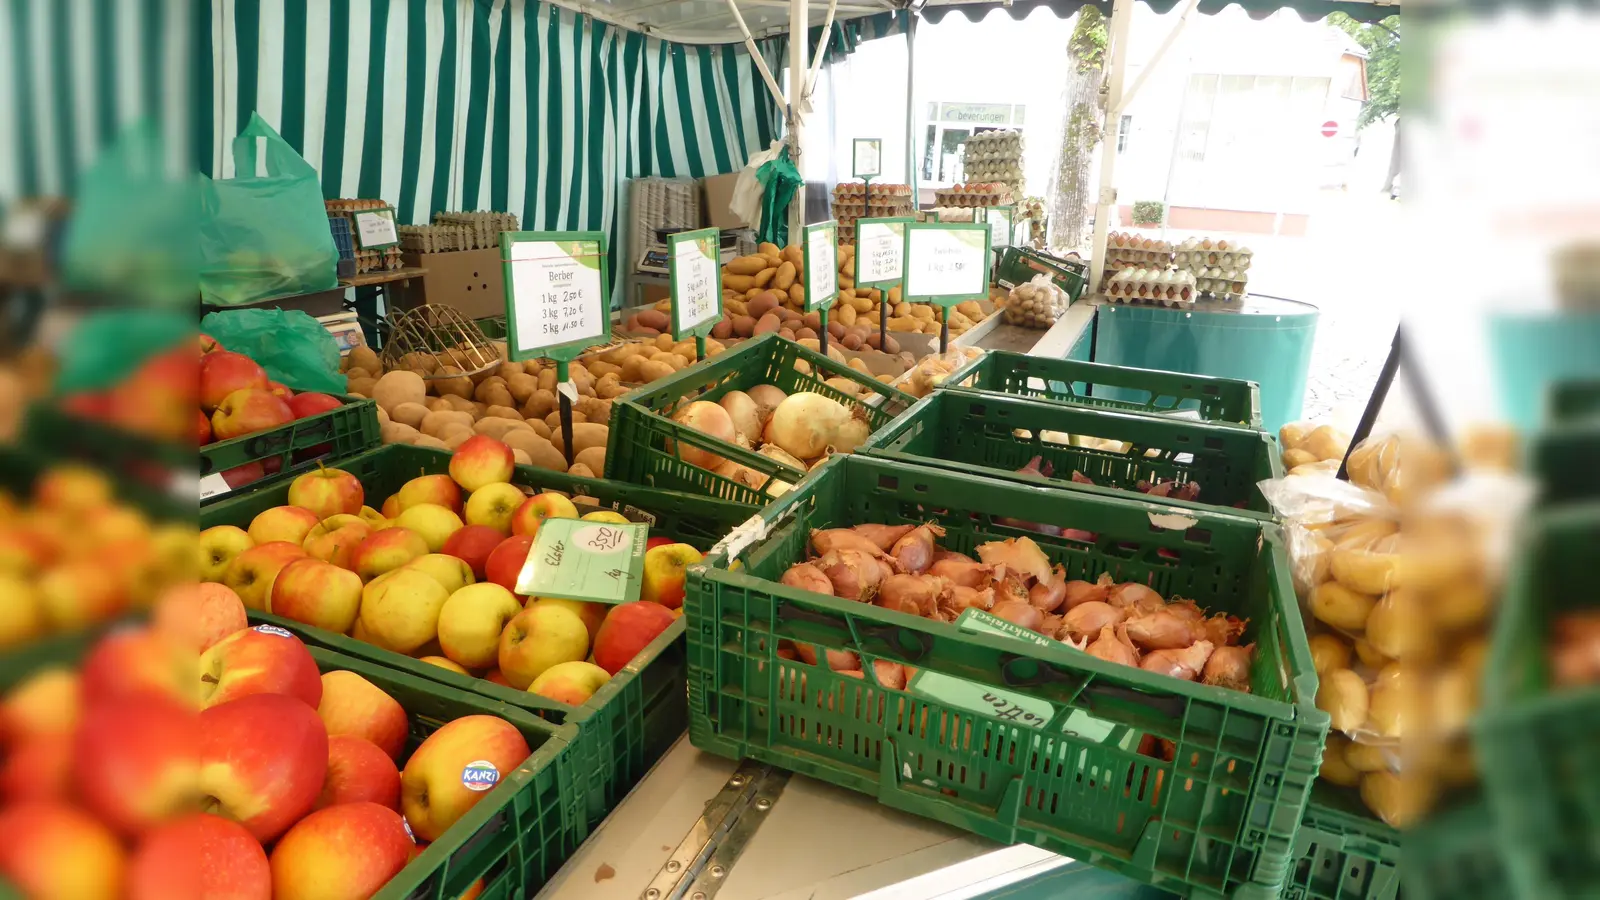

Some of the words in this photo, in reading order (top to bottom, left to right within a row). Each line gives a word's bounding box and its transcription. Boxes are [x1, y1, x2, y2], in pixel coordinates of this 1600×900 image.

[958, 112, 1004, 123] beverungen
[549, 270, 574, 281] Berber
[542, 294, 546, 304] 1
[548, 293, 557, 304] kg
[578, 289, 584, 299] €
[542, 309, 547, 319] 3
[548, 308, 558, 320] kg
[579, 304, 584, 313] €
[543, 324, 548, 334] 5
[550, 322, 559, 335] kg
[580, 318, 584, 328] €
[545, 540, 565, 566] Elster
[604, 568, 635, 580] kg
